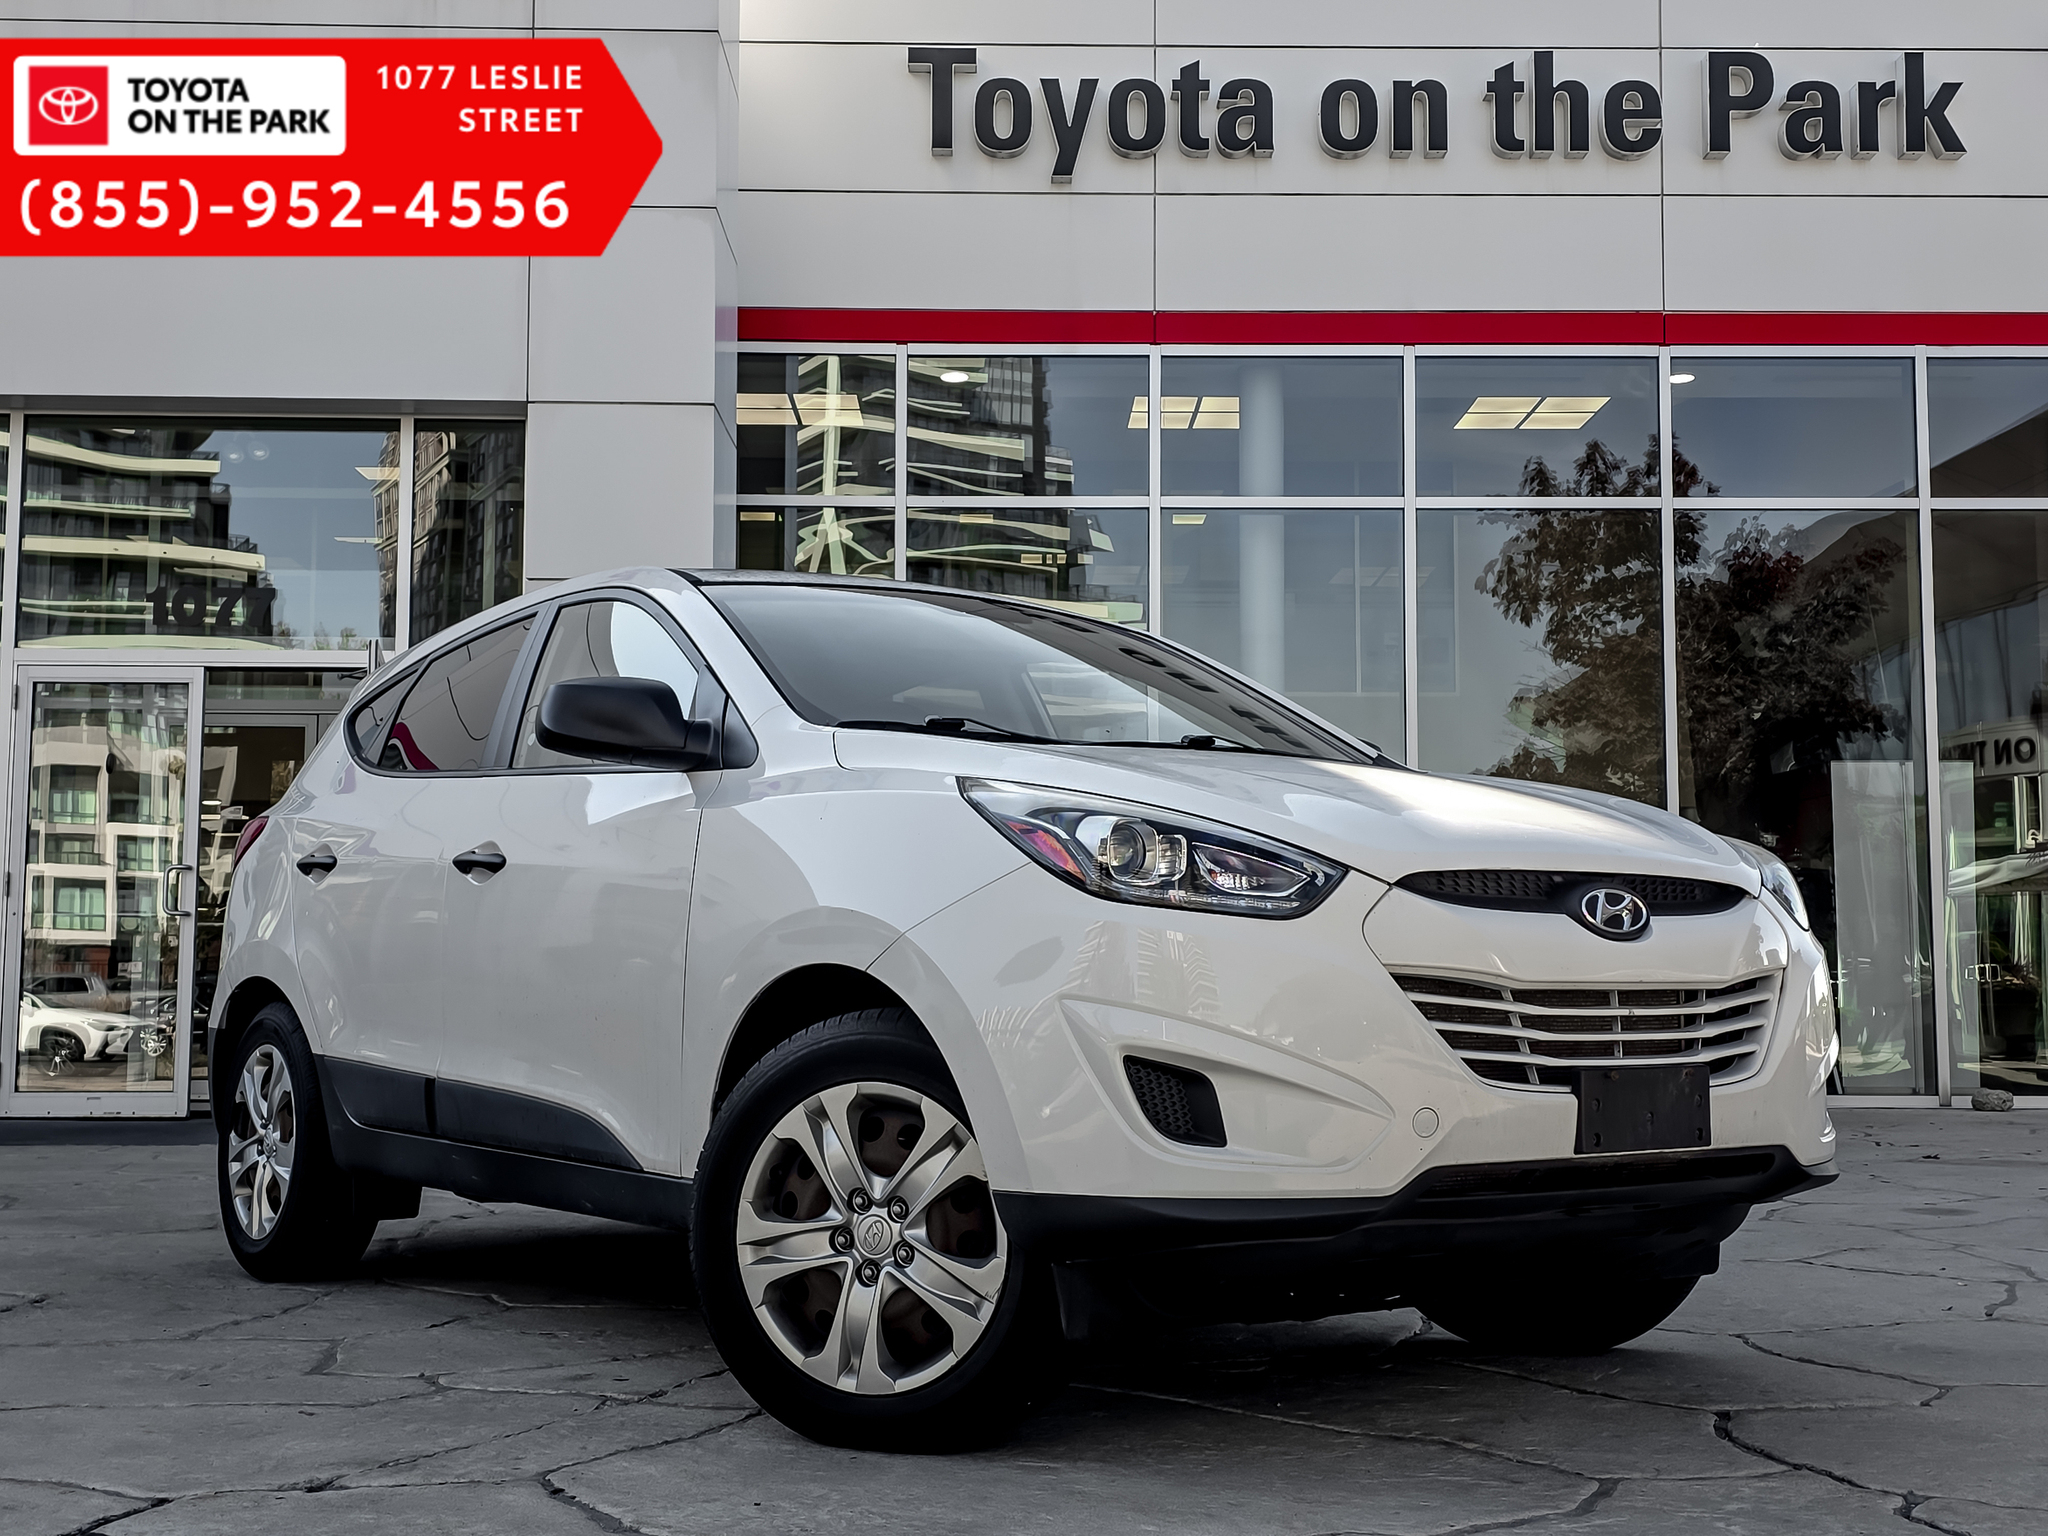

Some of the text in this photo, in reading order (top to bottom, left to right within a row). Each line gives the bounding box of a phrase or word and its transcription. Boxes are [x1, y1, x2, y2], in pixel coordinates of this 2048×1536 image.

[907, 46, 1968, 183] Toyota on the Park
[146, 585, 276, 627] 1077
